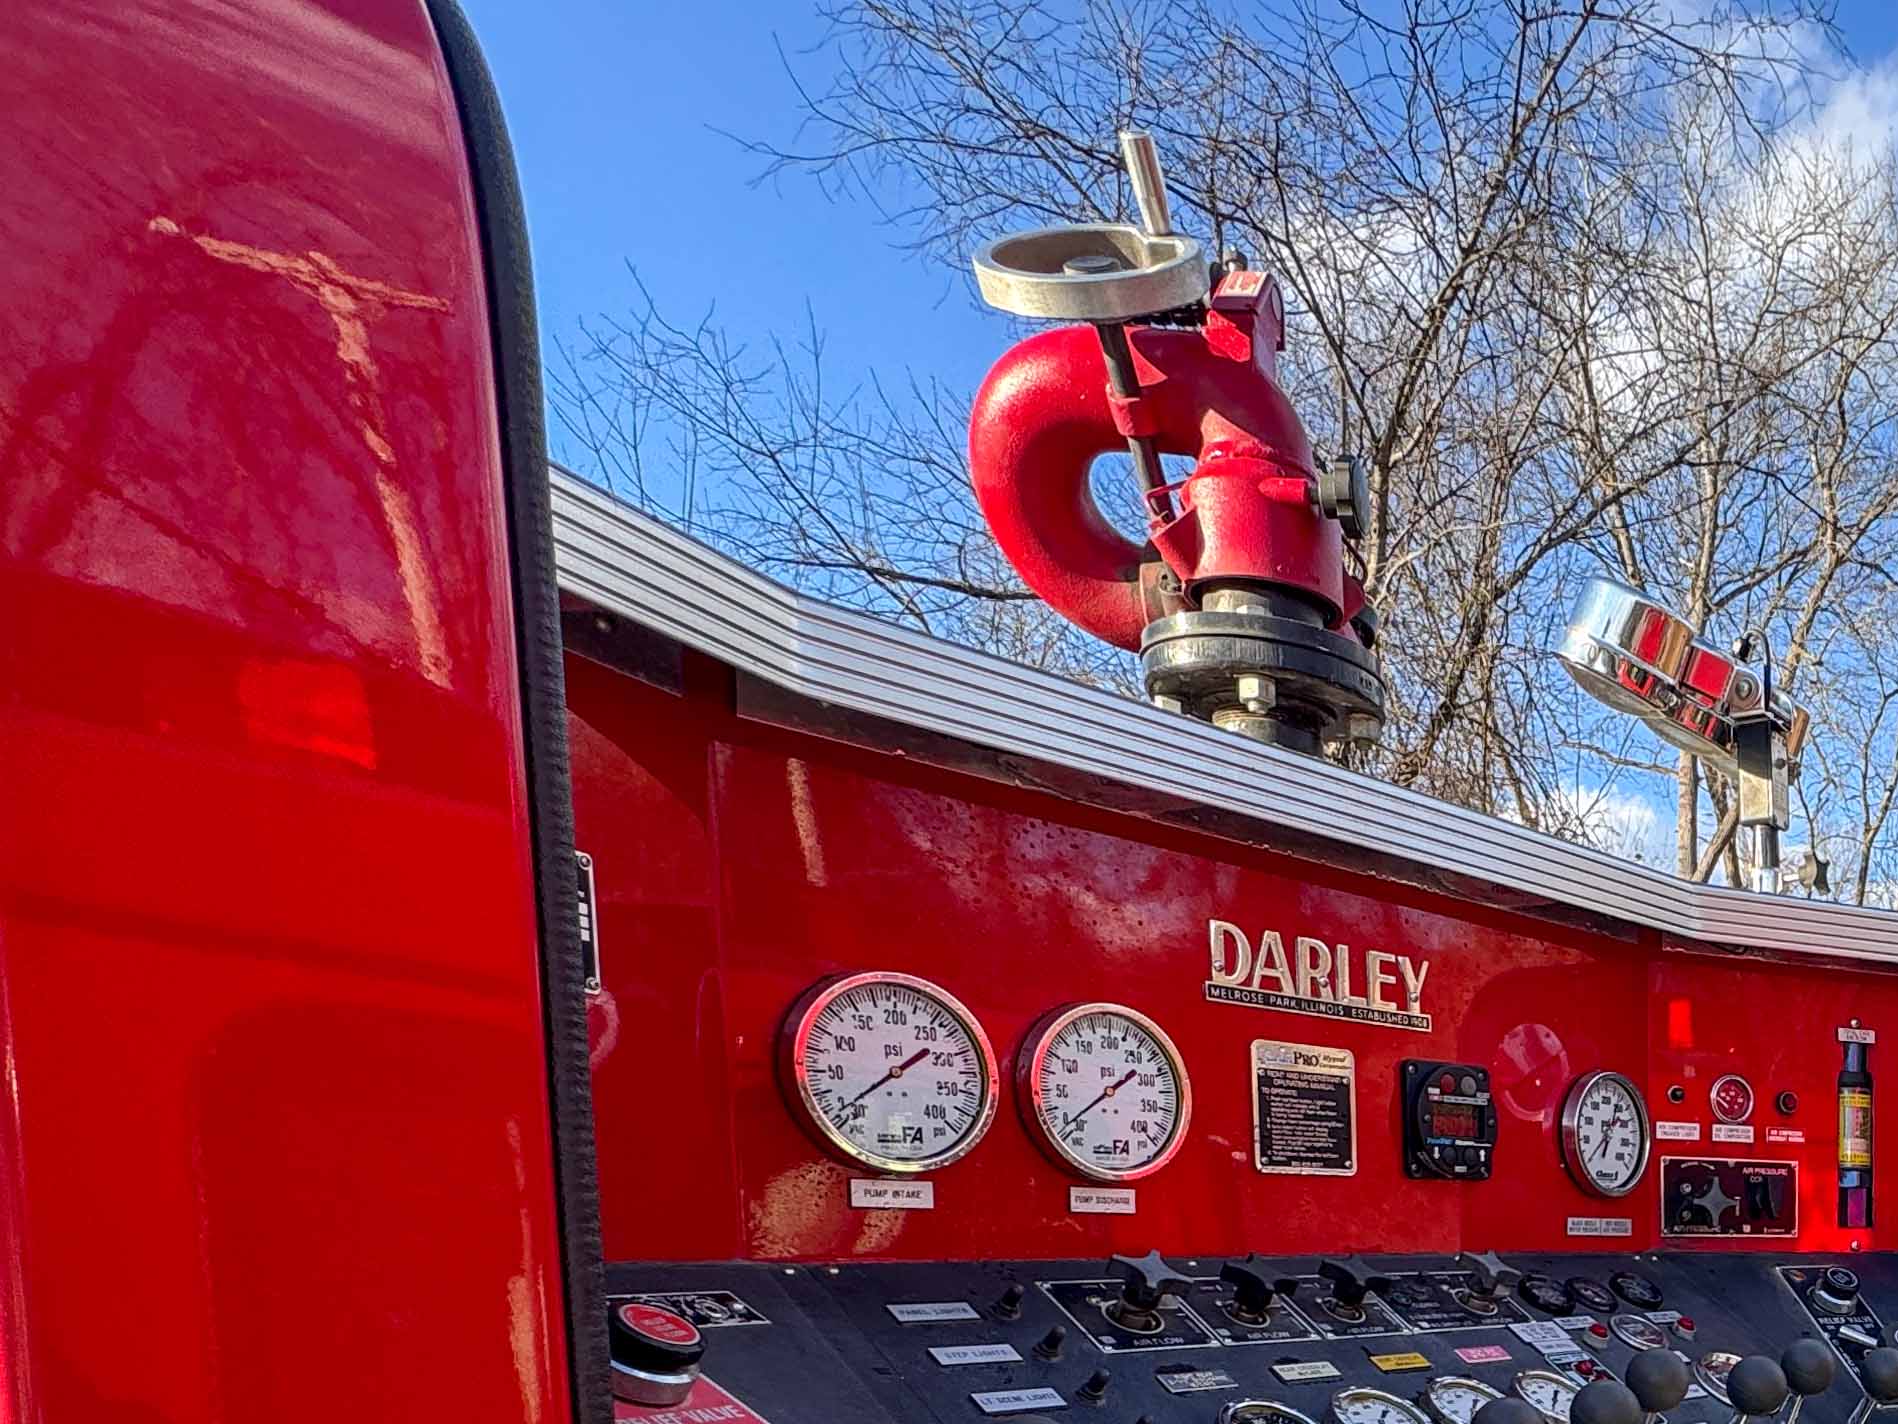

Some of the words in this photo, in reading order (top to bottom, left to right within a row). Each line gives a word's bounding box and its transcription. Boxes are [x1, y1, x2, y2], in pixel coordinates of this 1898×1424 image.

[1209, 919, 1429, 1014] DARLEY
[1211, 986, 1265, 1003] MELROSE
[1301, 1000, 1344, 1015] ILLINOIS
[1351, 1008, 1409, 1024] ESTABLISHED
[883, 1009, 907, 1026] 200
[914, 1025, 937, 1042] 250
[884, 1042, 903, 1059] psi
[1075, 1040, 1092, 1055] 150
[1100, 1035, 1119, 1050] 200
[1100, 1066, 1115, 1081] psi
[1137, 1074, 1155, 1087] 300
[1141, 1099, 1158, 1113] 350
[863, 1188, 888, 1199] PUMP
[891, 1189, 922, 1200] INTAKE
[683, 1404, 745, 1423] VALVE
